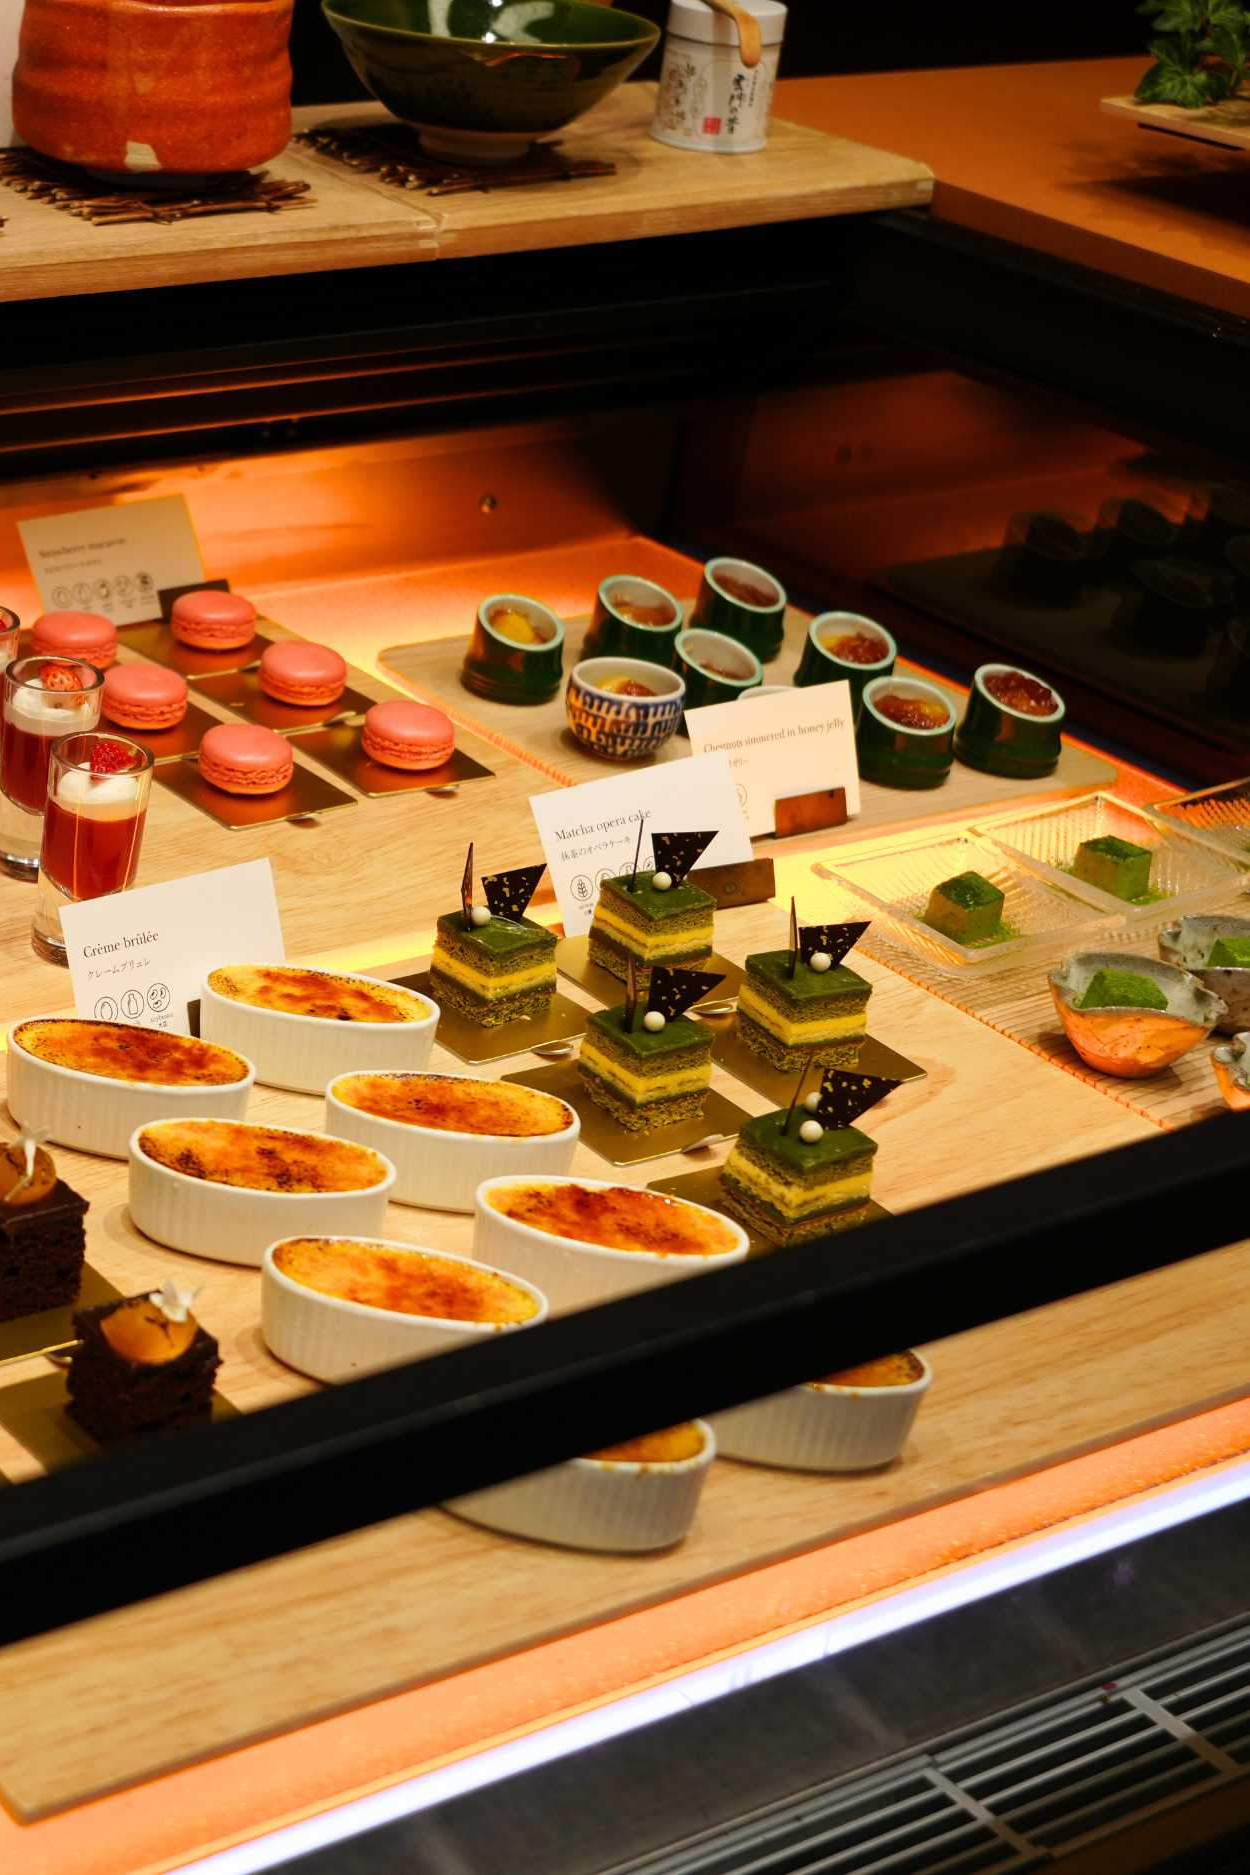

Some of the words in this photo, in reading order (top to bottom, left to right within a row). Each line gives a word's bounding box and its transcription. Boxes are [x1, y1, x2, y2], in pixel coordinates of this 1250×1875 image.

[745, 729, 785, 745] simmered
[787, 728, 796, 738] in
[798, 724, 824, 737] honey
[826, 717, 846, 733] jelly
[554, 822, 594, 841] Matcha
[596, 816, 626, 832] opera
[629, 809, 651, 823] cake
[83, 943, 121, 958] Crème
[123, 931, 159, 949] brûlée
